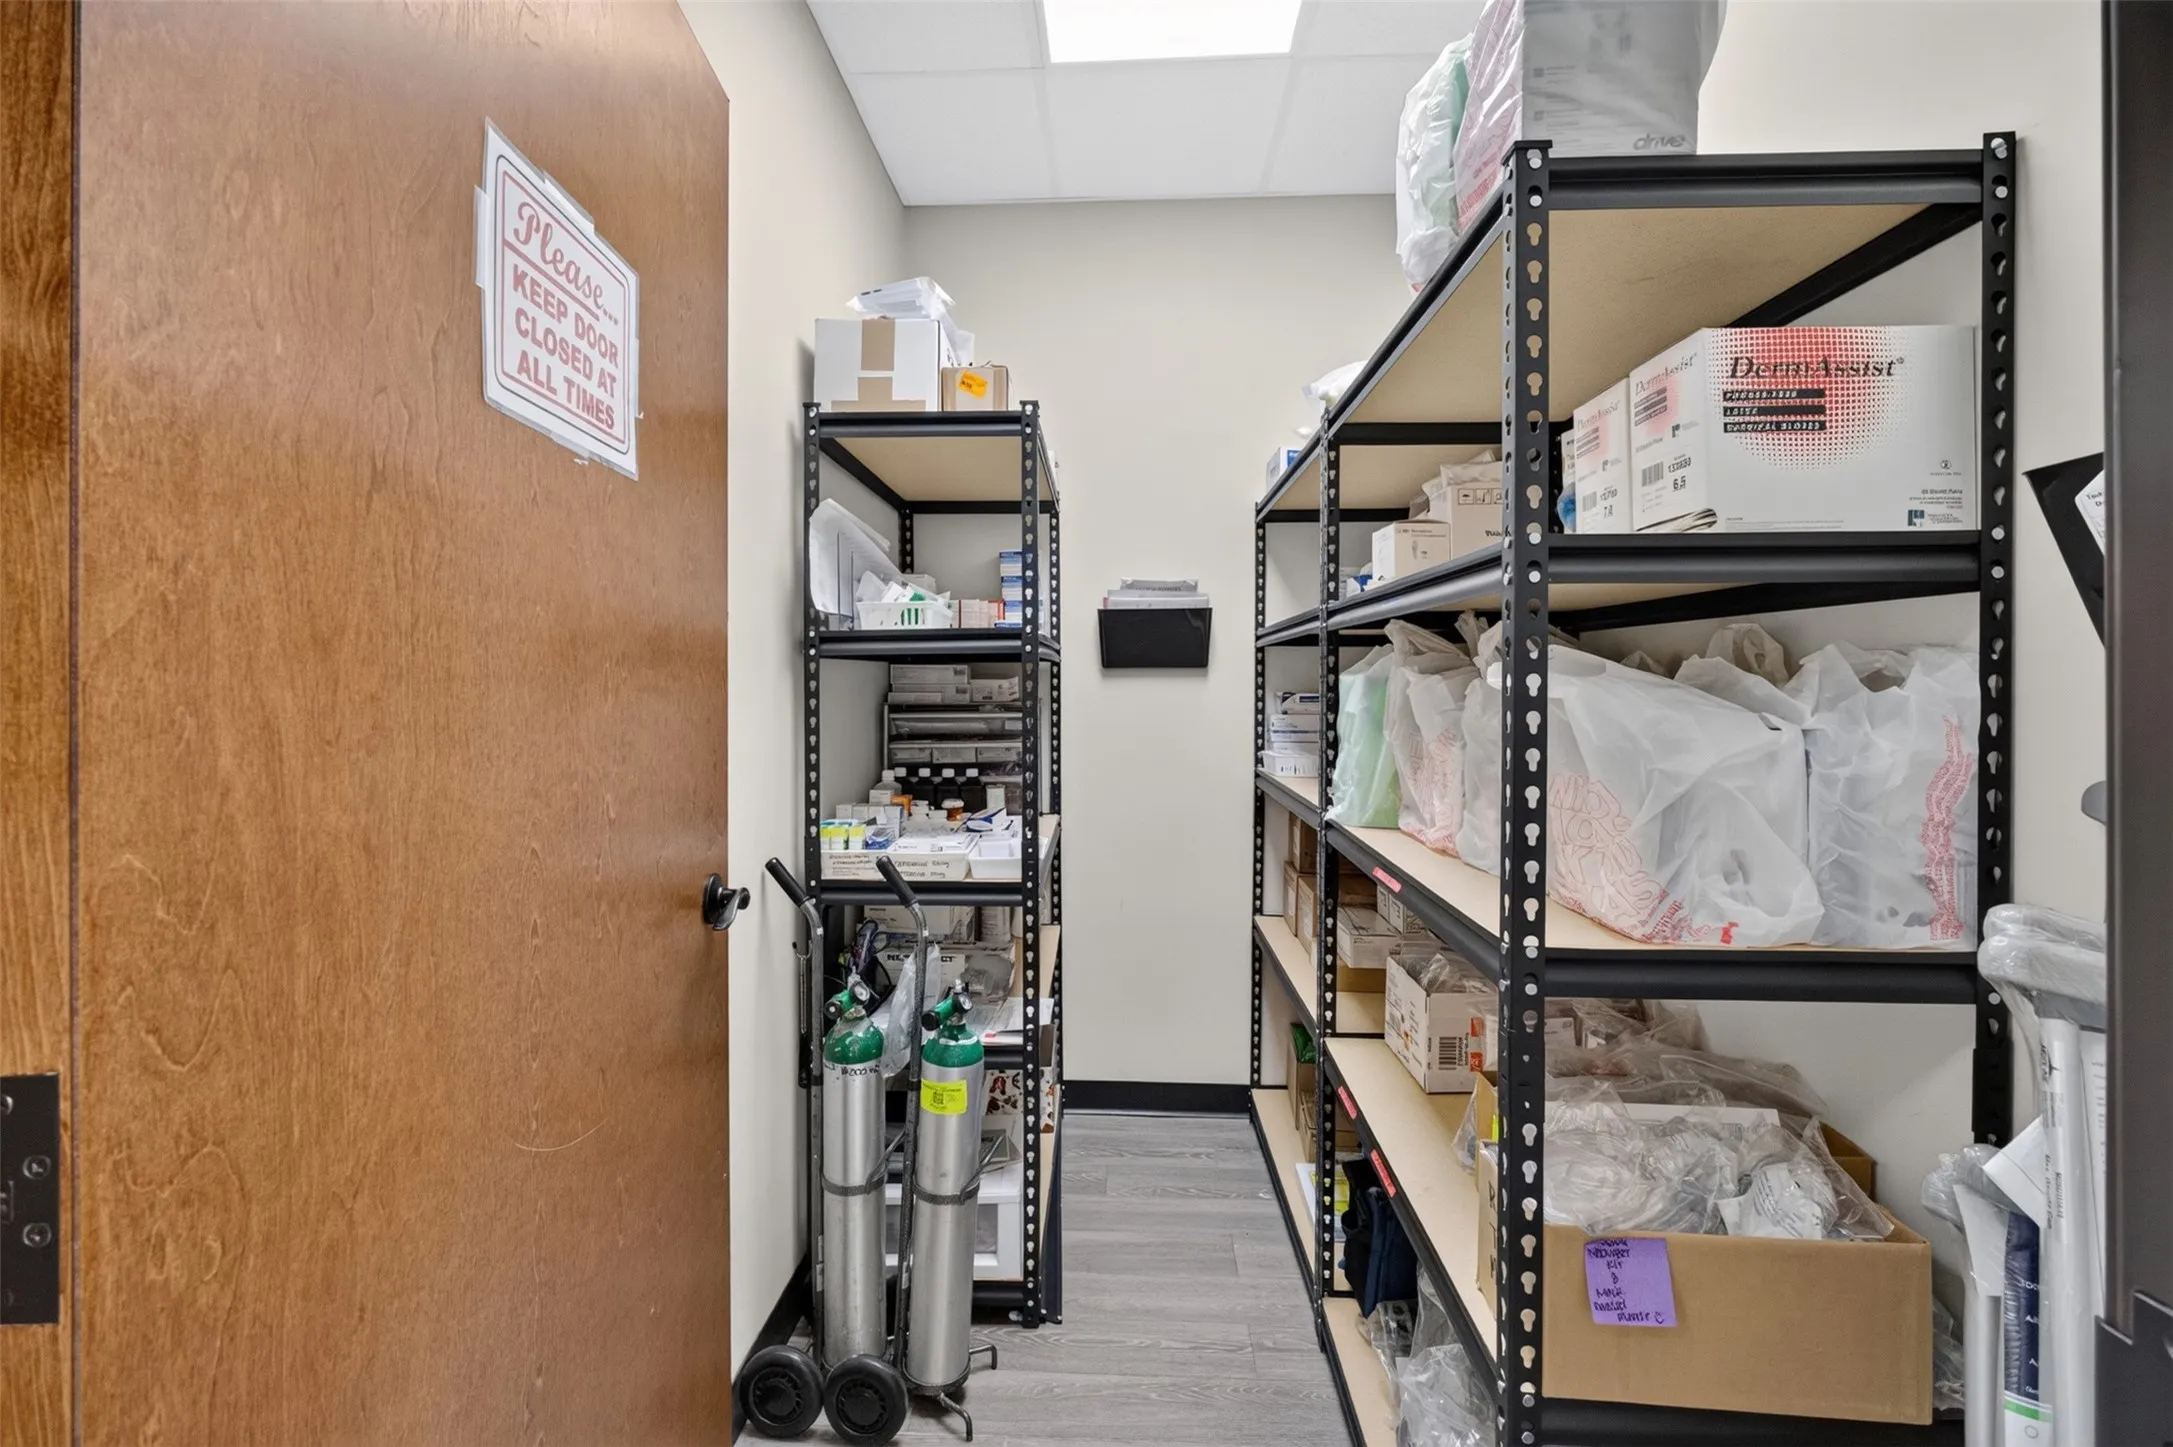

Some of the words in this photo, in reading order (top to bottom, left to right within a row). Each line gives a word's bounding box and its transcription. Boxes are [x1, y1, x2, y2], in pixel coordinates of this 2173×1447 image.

[1633, 133, 1685, 151] drive
[512, 263, 568, 325] KEEP
[574, 310, 619, 370] DOOR
[515, 307, 594, 382] CLOSED
[597, 367, 617, 399] AT
[516, 350, 558, 397] ALL
[563, 377, 615, 431] TIMES
